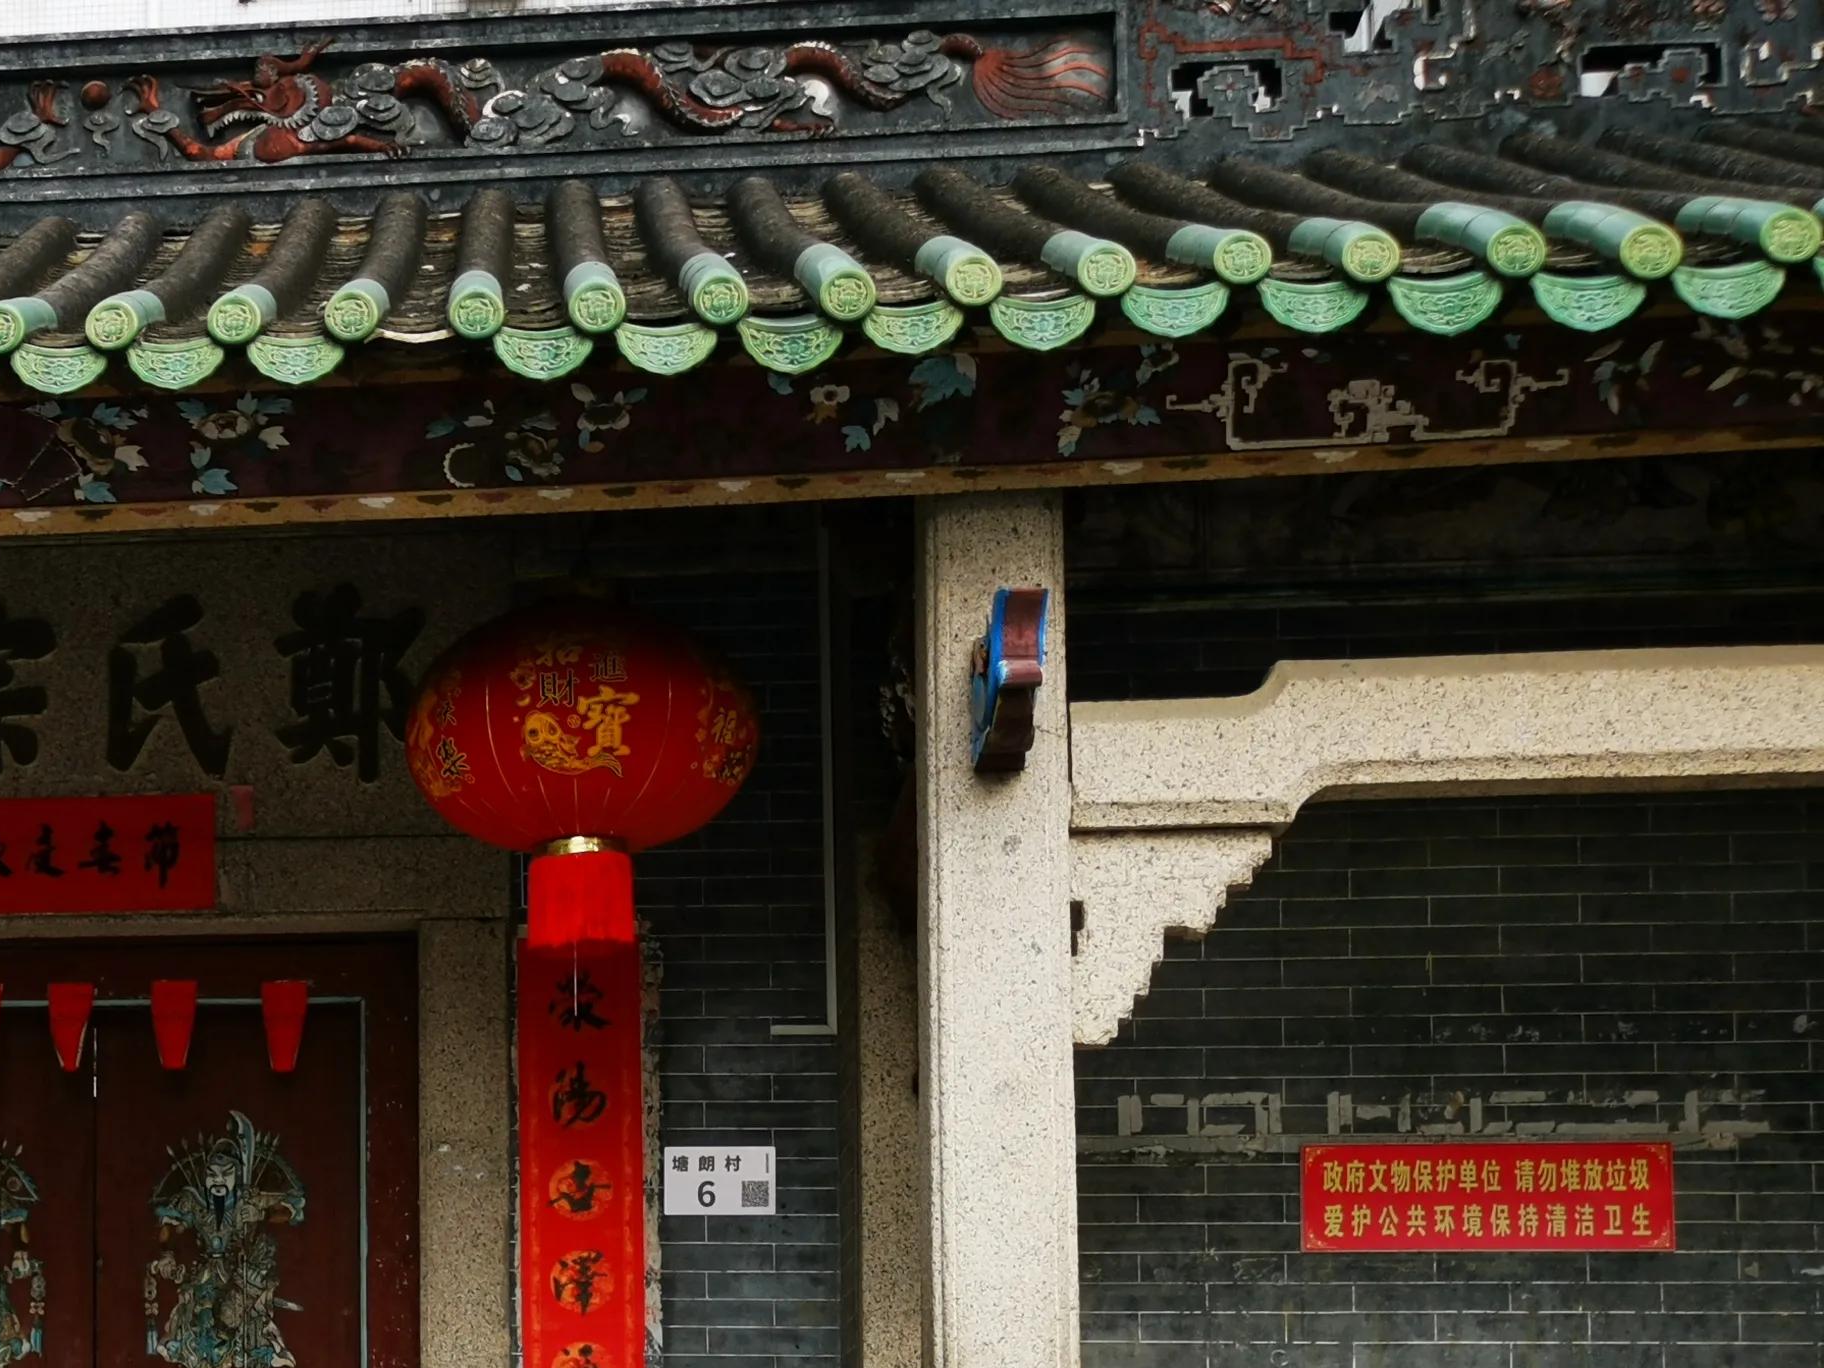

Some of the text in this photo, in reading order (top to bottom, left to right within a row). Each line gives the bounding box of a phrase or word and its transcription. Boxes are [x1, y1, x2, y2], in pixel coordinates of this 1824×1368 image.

[672, 1155, 742, 1172] 塘朗村
[1323, 1157, 1650, 1194] 政府文物保护单位 请勿堆放垃圾
[697, 1181, 716, 1208] 6
[1323, 1202, 1653, 1239] 爱护公共环境保持清洁卫生
